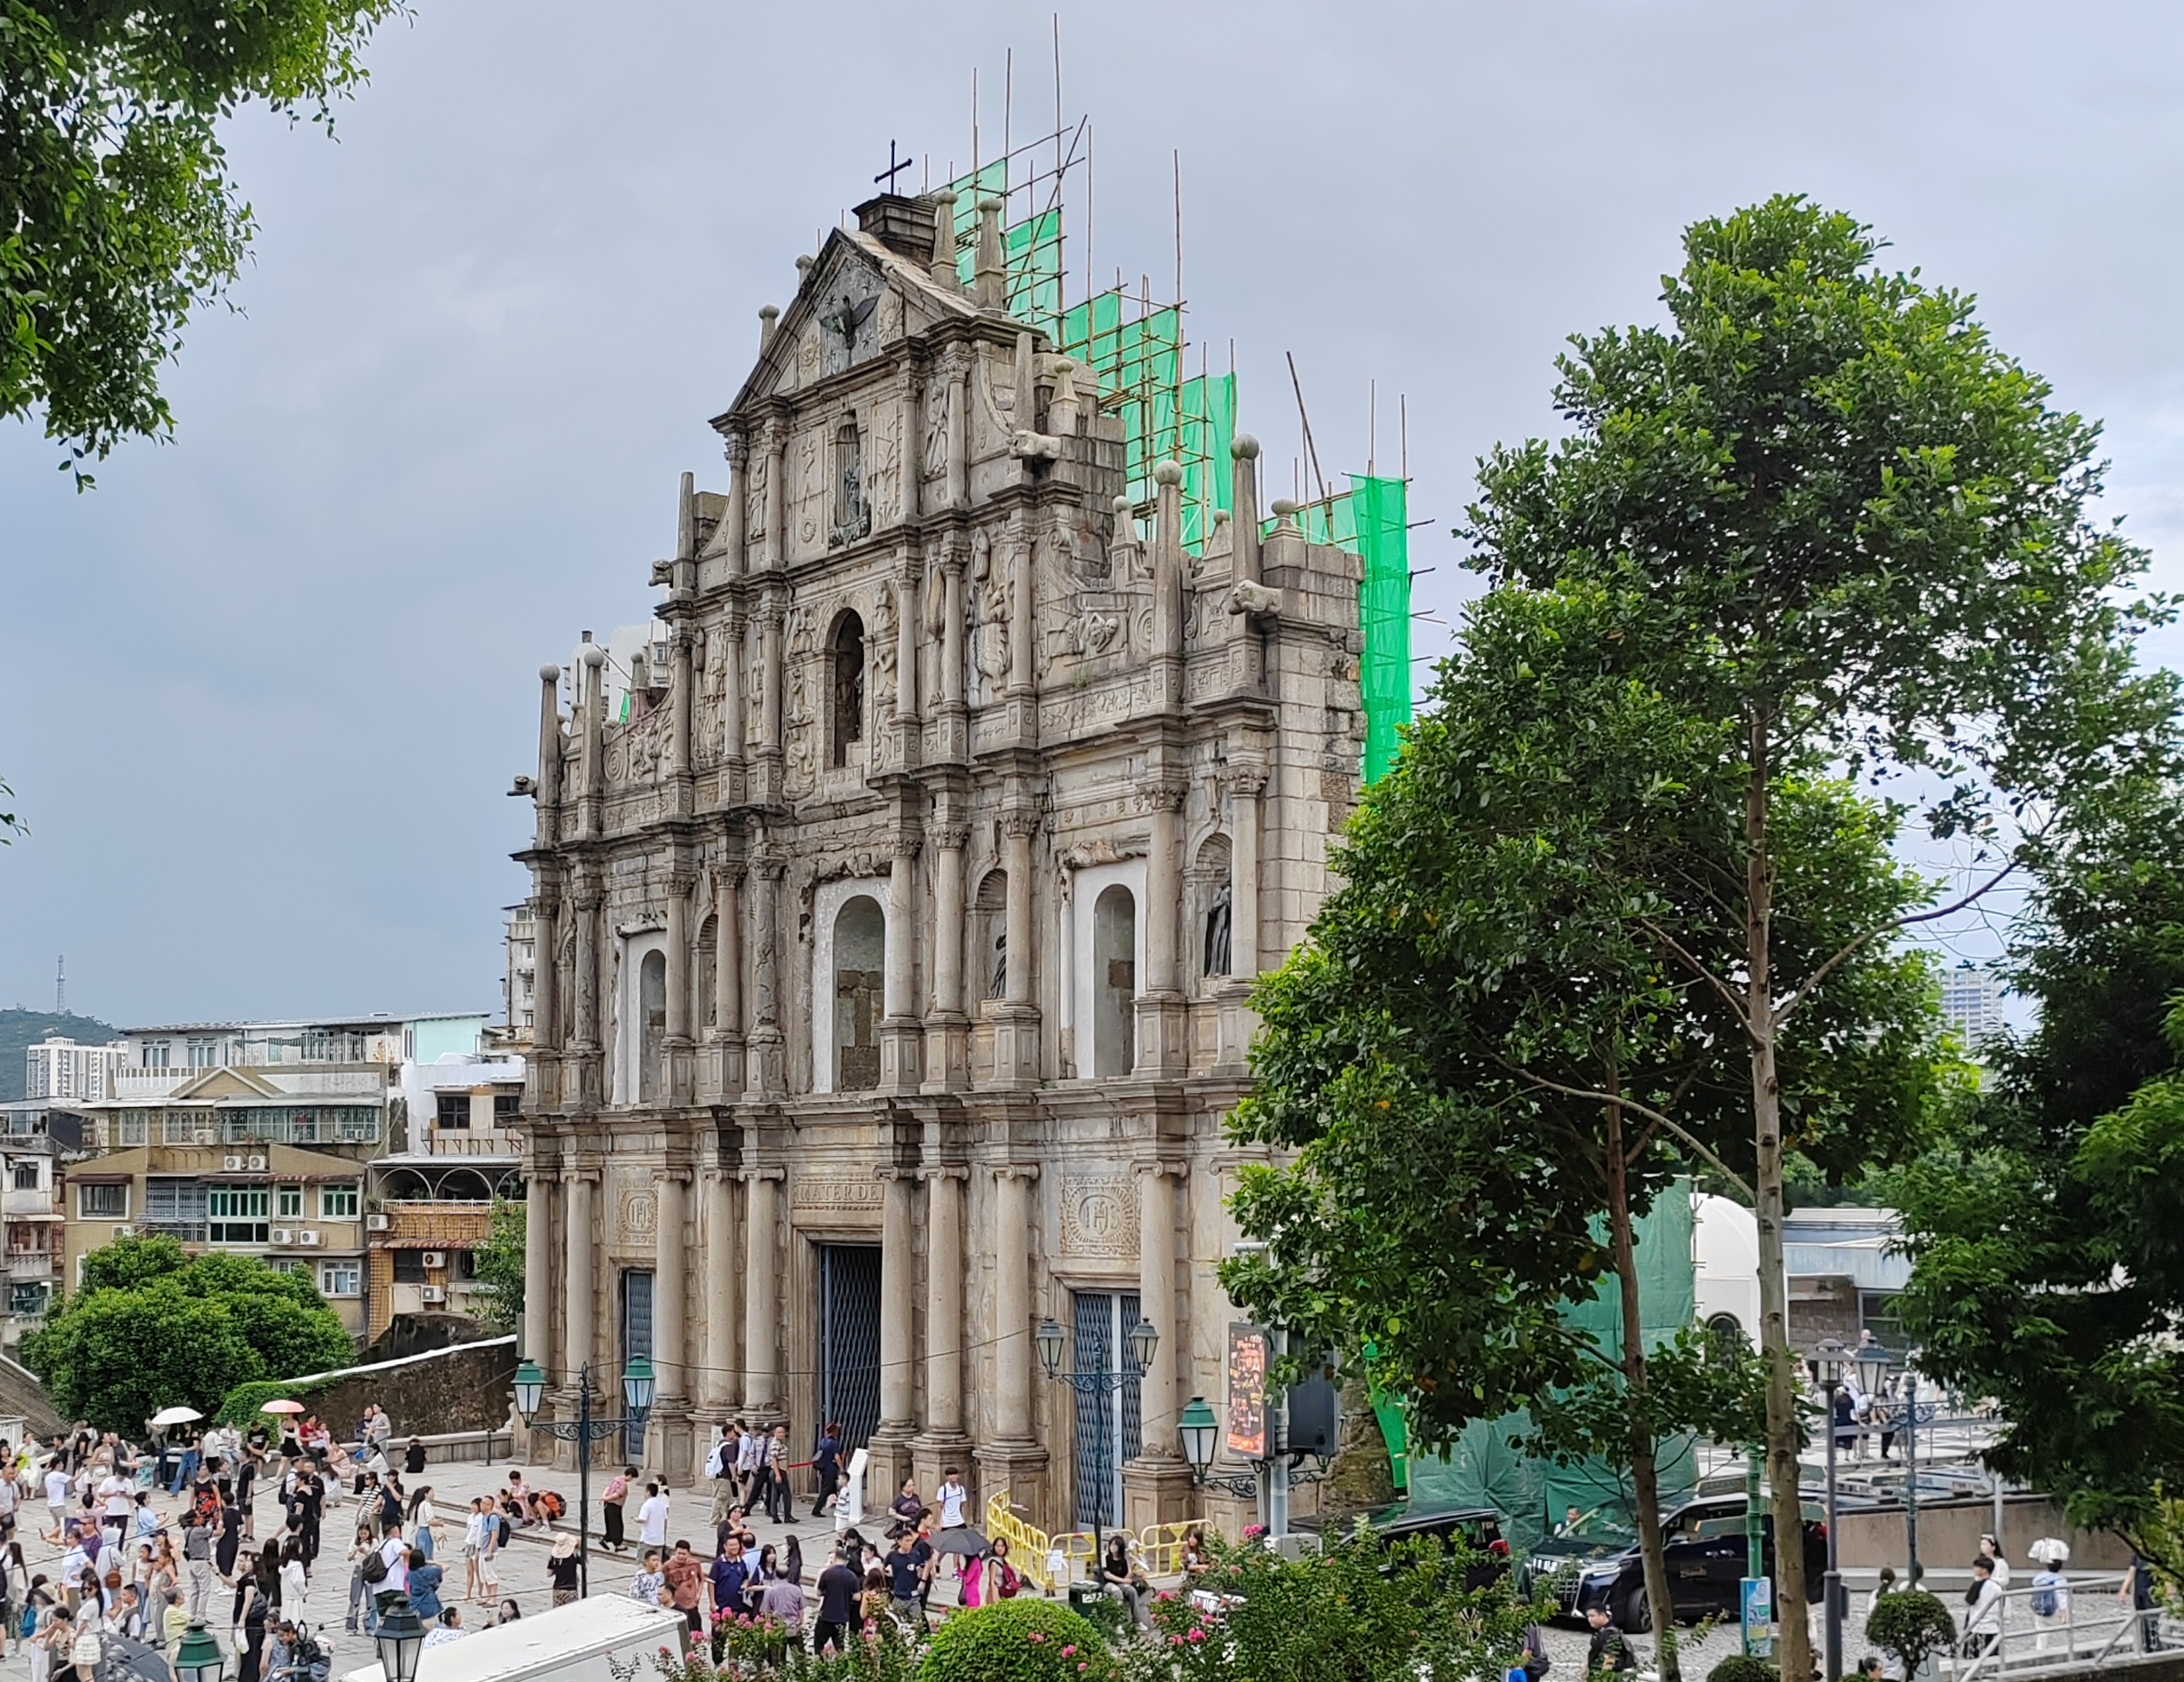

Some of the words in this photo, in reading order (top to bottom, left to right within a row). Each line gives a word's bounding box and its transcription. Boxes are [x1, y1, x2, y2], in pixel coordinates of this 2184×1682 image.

[798, 1185, 853, 1201] MATER
[857, 1184, 884, 1201] DEI
[631, 1202, 654, 1224] IHS
[1085, 1203, 1120, 1230] IHS
